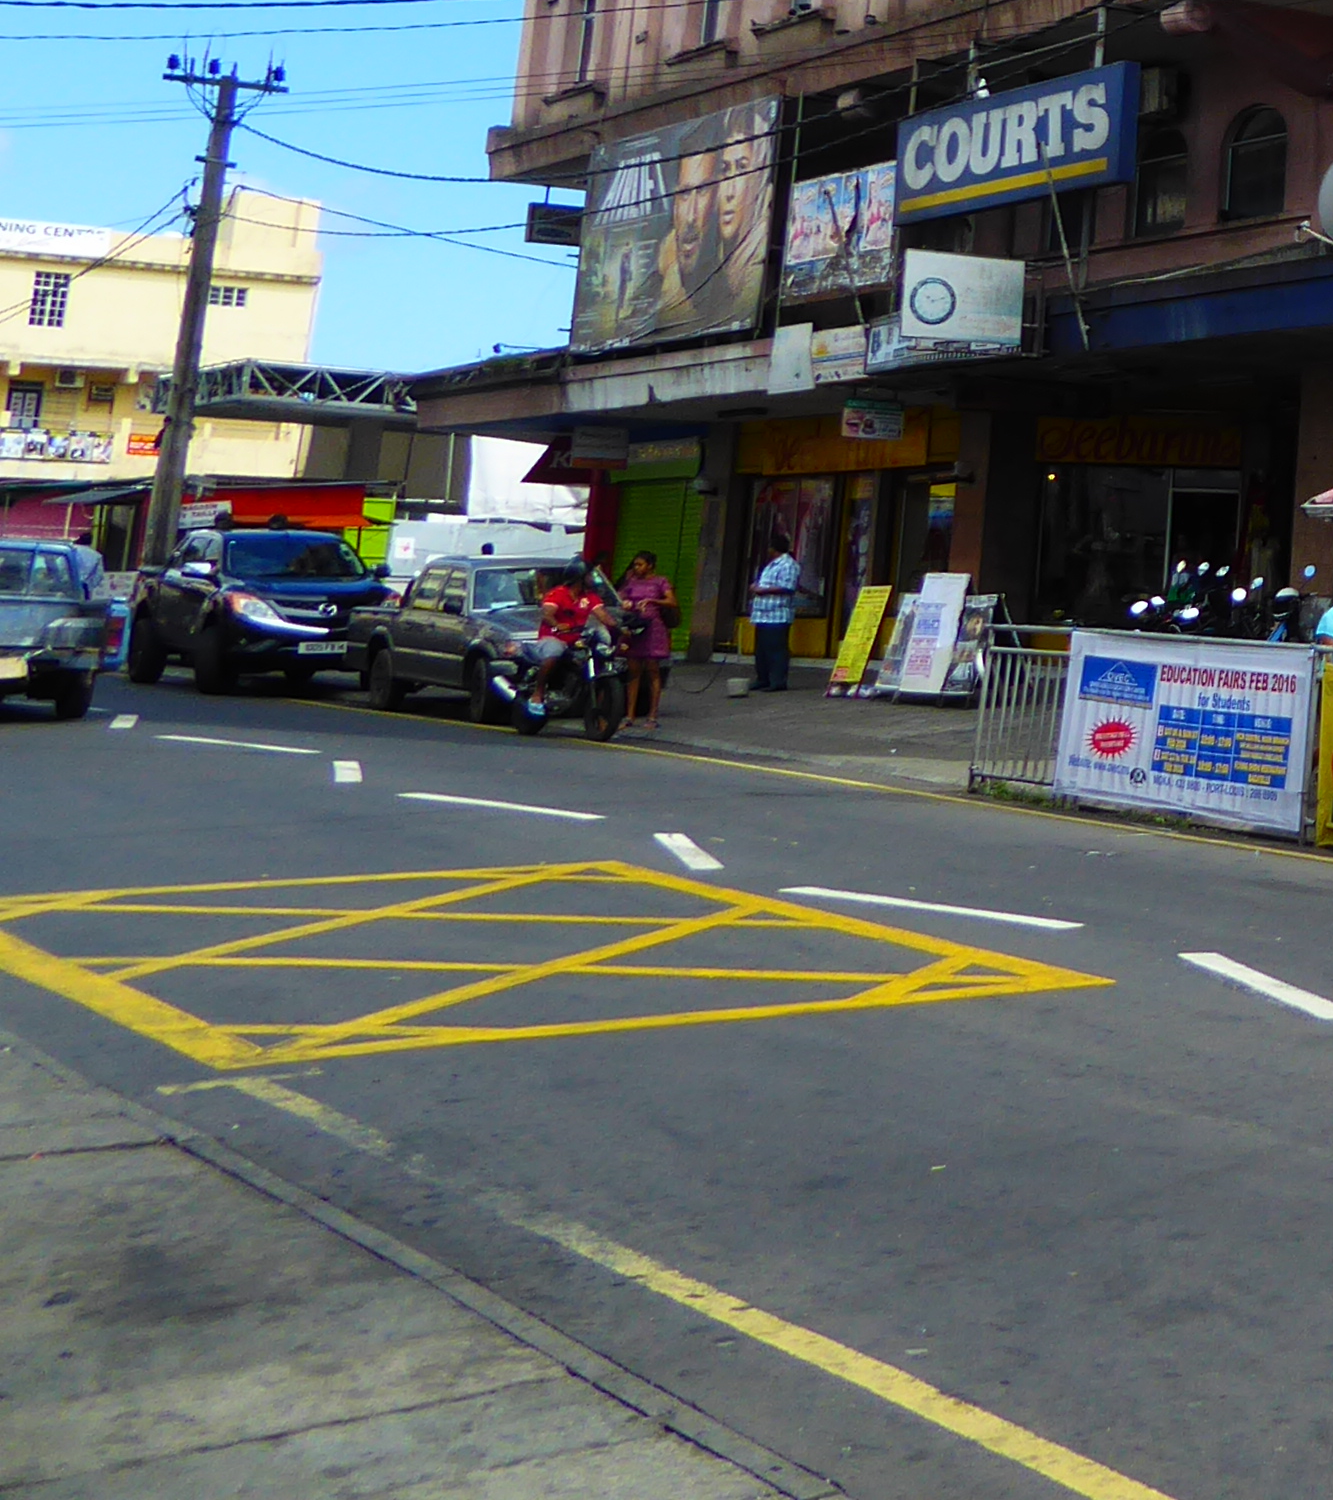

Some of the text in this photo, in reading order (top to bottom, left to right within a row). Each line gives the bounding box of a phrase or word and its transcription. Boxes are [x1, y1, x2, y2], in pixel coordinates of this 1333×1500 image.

[903, 82, 1110, 190] COURTS
[1160, 665, 1297, 693] EDUCATION FAIRS FEB 2016
[1198, 692, 1251, 711] for Students
